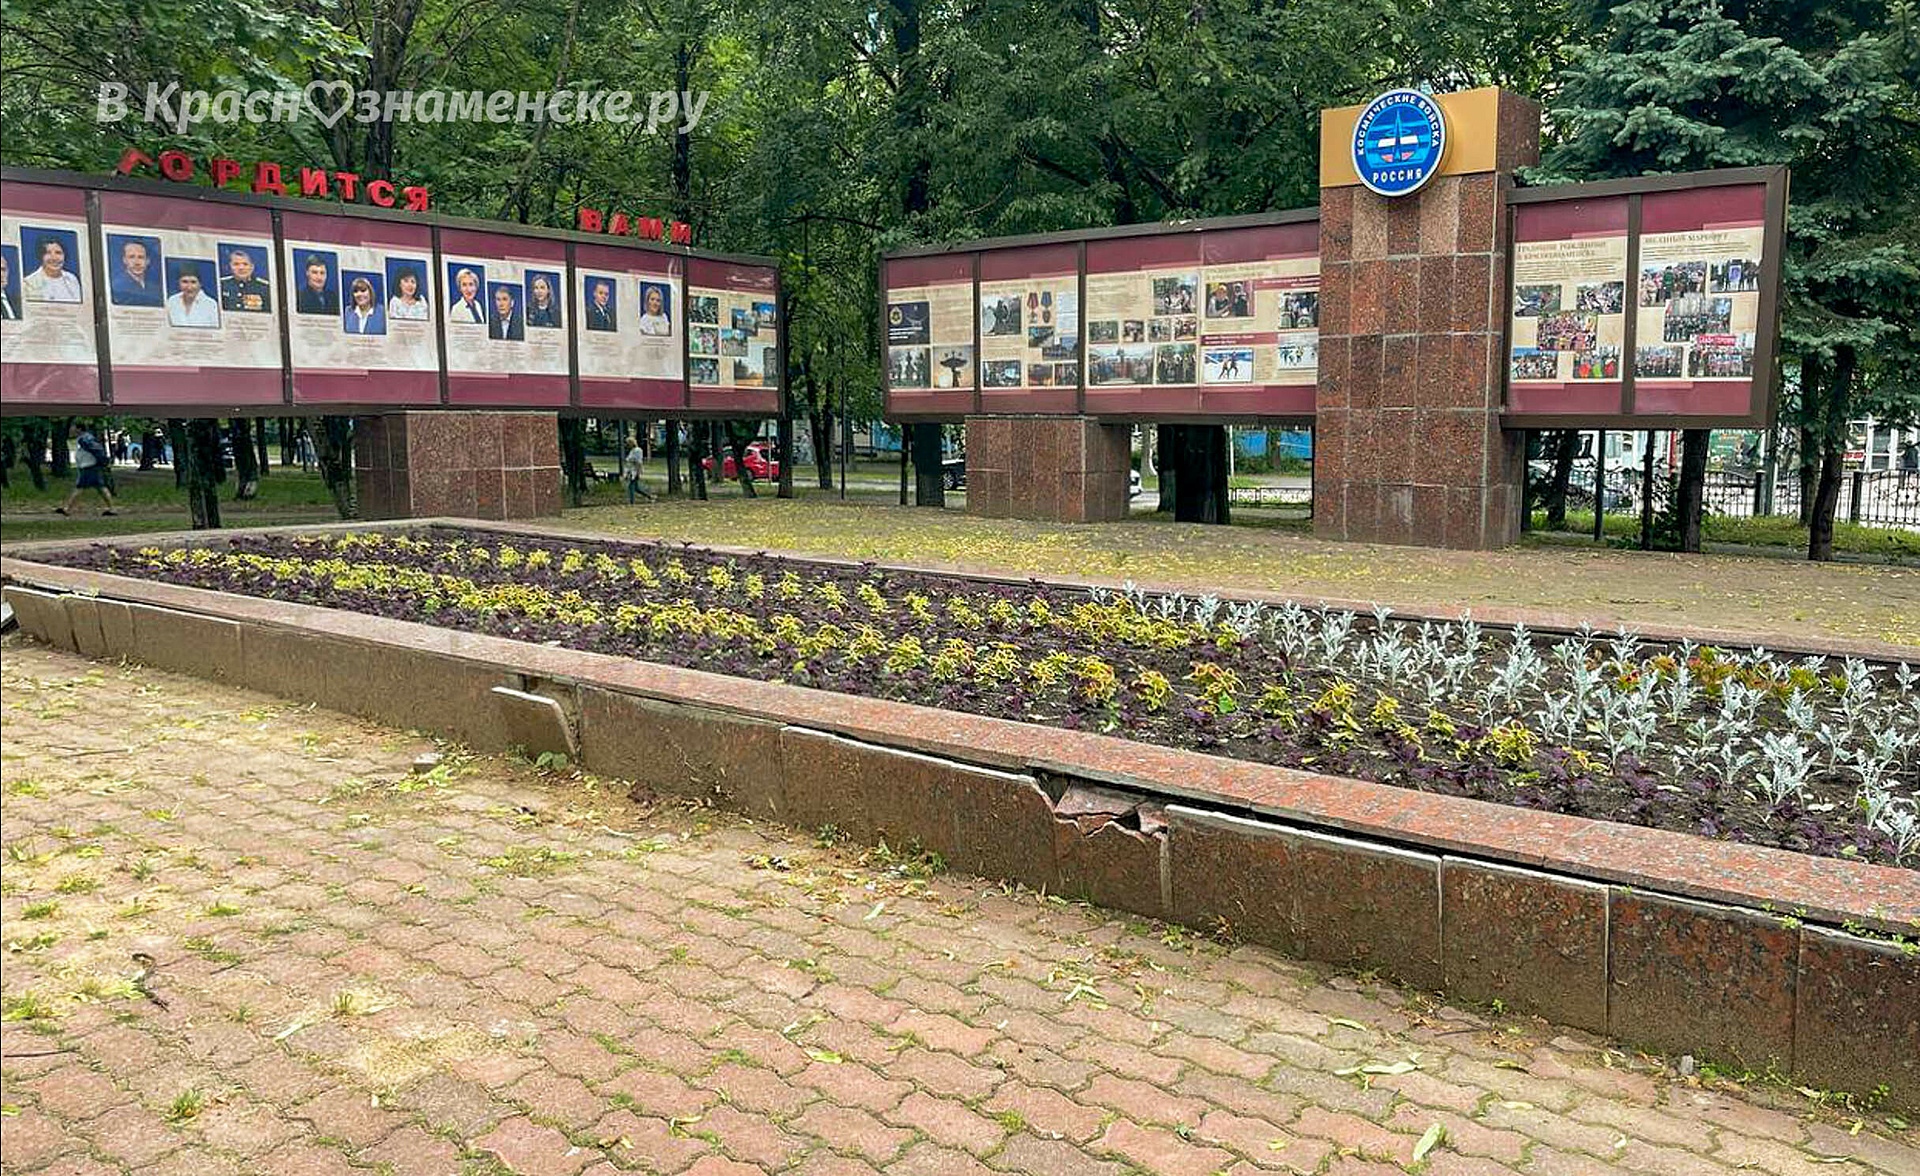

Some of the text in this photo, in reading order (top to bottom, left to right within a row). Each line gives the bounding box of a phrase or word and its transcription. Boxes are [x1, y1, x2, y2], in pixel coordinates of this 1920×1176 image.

[1357, 94, 1440, 155] КОСМИЧЕСКИЕ ВОЙСКА
[116, 147, 430, 212] ГОРДИТСЯ
[1373, 168, 1423, 183] РОССИЯ
